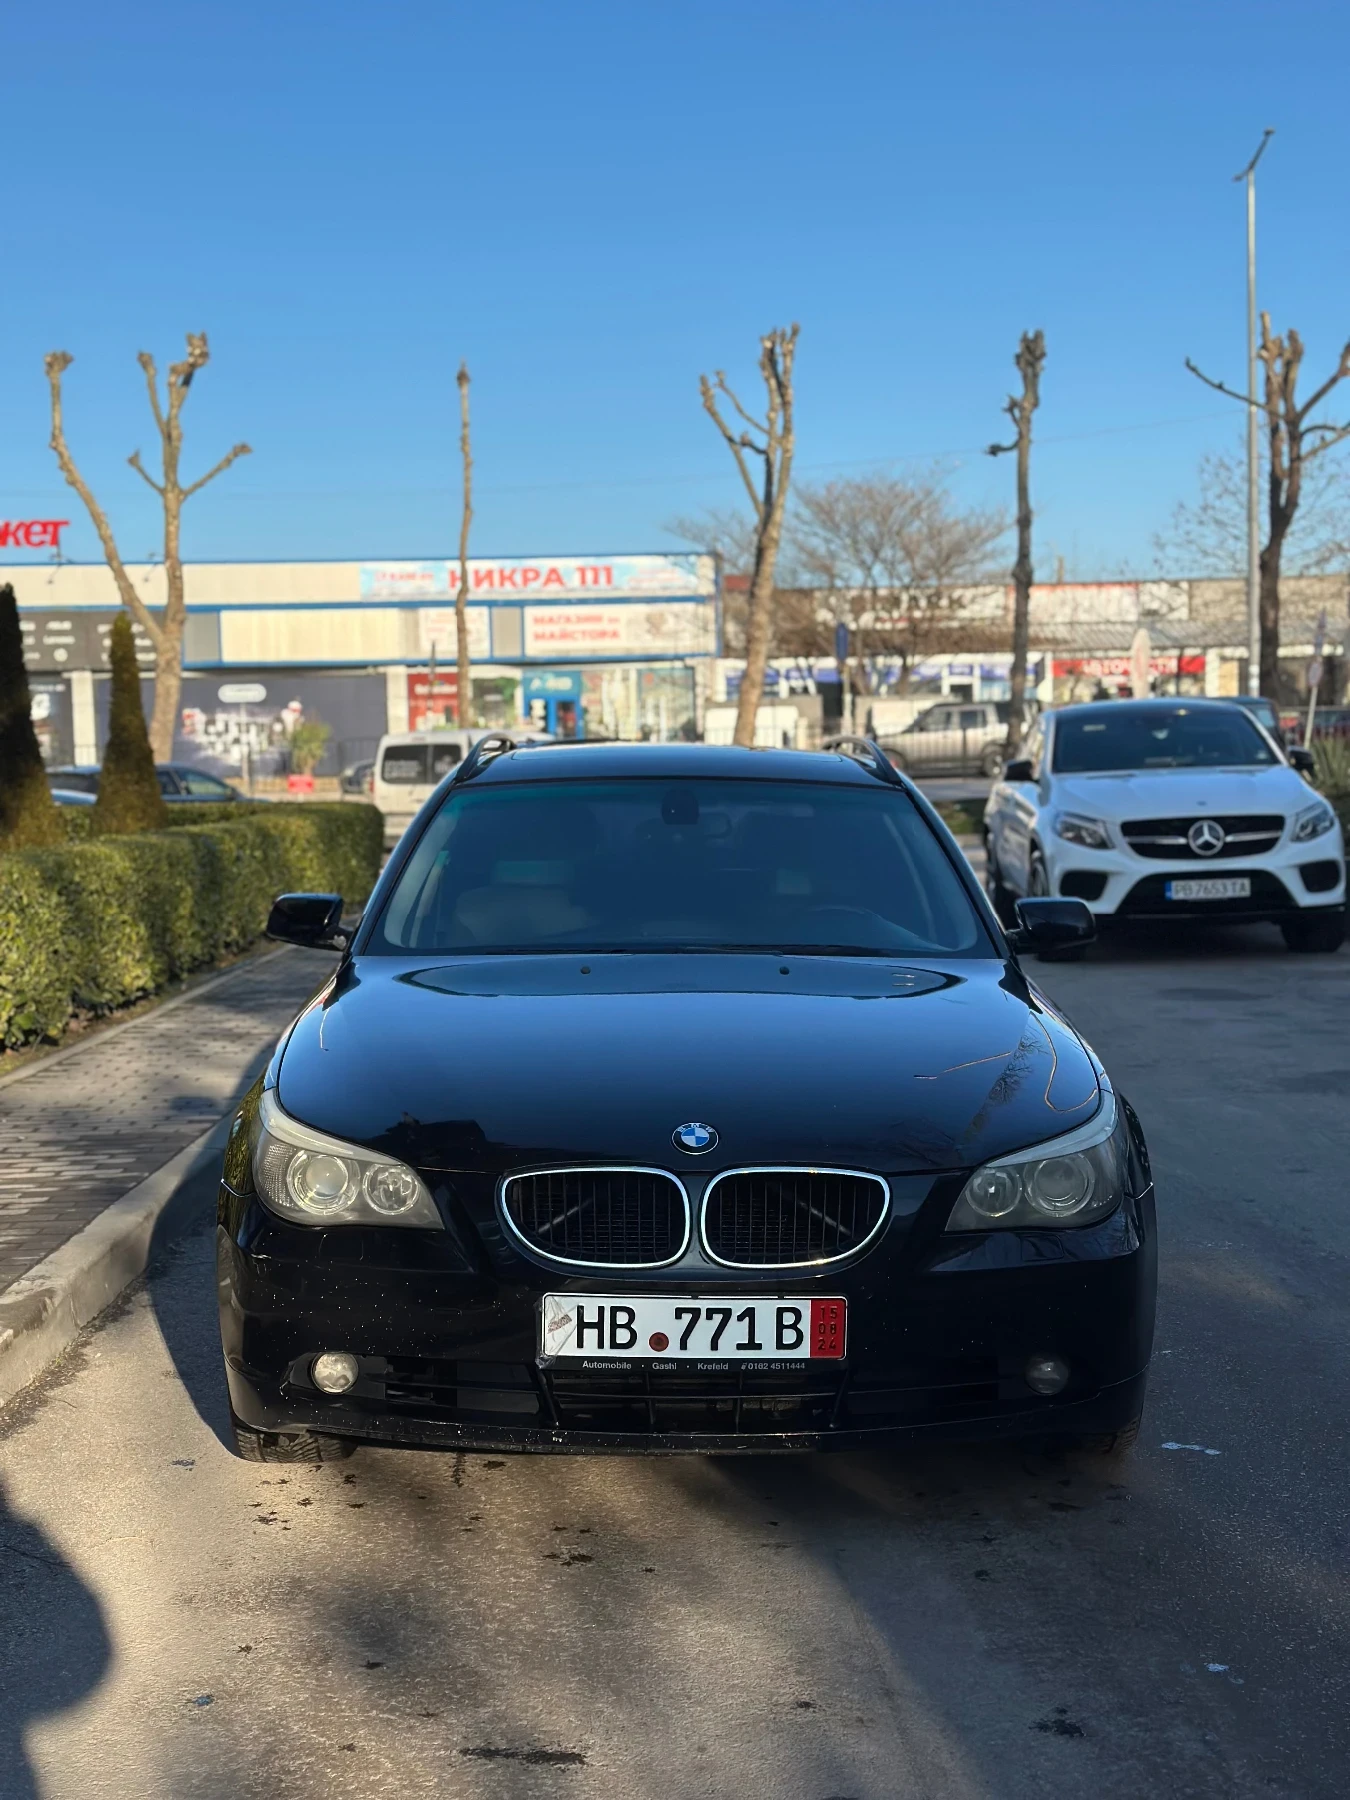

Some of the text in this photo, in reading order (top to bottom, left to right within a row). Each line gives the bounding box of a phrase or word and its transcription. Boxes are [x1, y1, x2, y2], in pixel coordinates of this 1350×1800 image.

[576, 565, 613, 587] 111
[820, 1306, 838, 1319] 15
[576, 1305, 804, 1351] HB 771 B
[818, 1321, 837, 1334] 08
[818, 1337, 837, 1350] 24
[582, 1360, 632, 1370] Automobile
[697, 1362, 729, 1370] Krefeld
